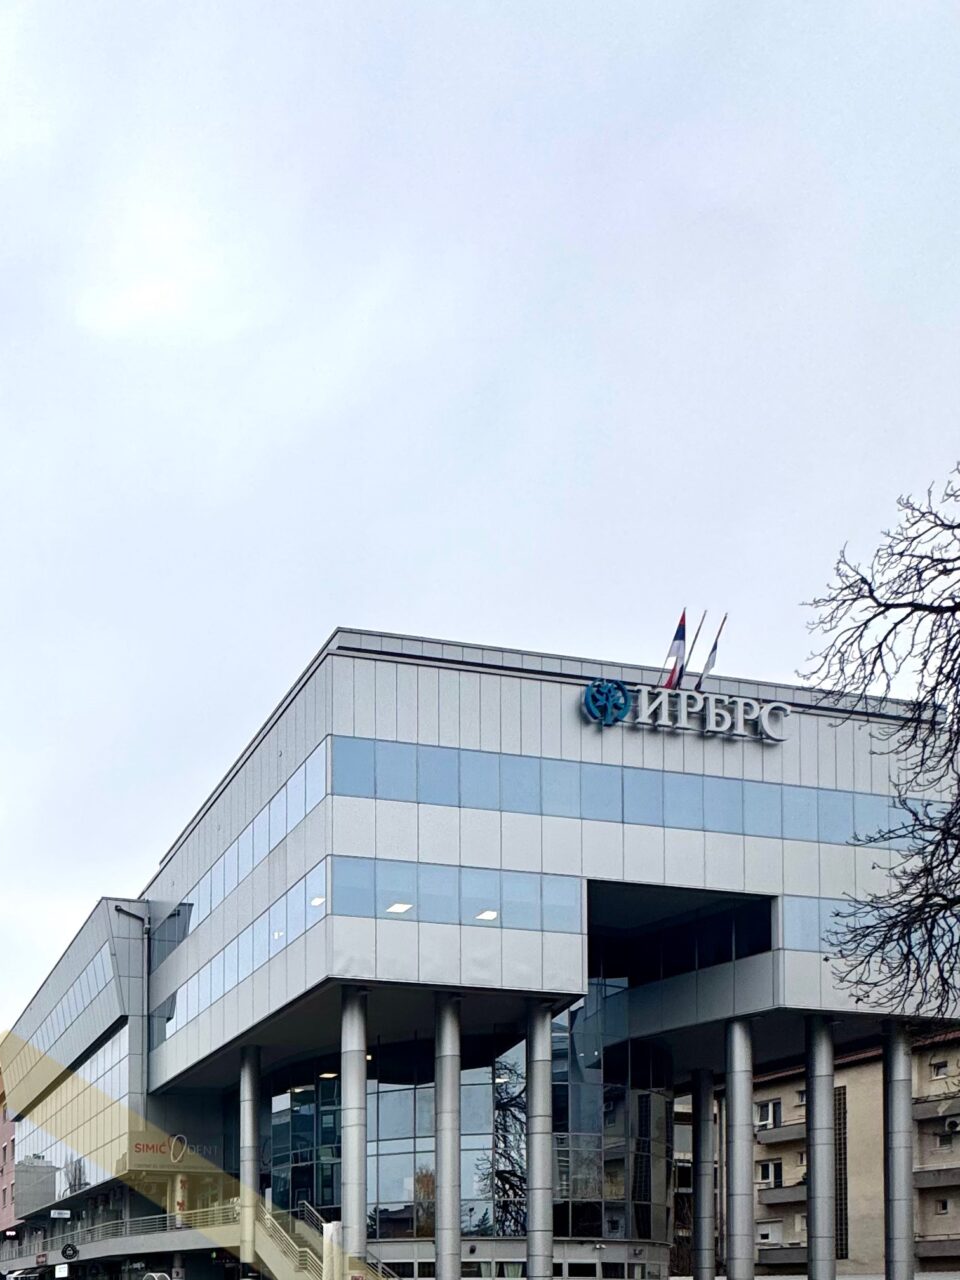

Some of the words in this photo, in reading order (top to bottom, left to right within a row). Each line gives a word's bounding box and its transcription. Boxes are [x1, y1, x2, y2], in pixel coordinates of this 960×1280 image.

[631, 685, 791, 742] ИРБРС
[134, 1142, 167, 1154] SIMIĆ
[187, 1144, 218, 1156] DENT
